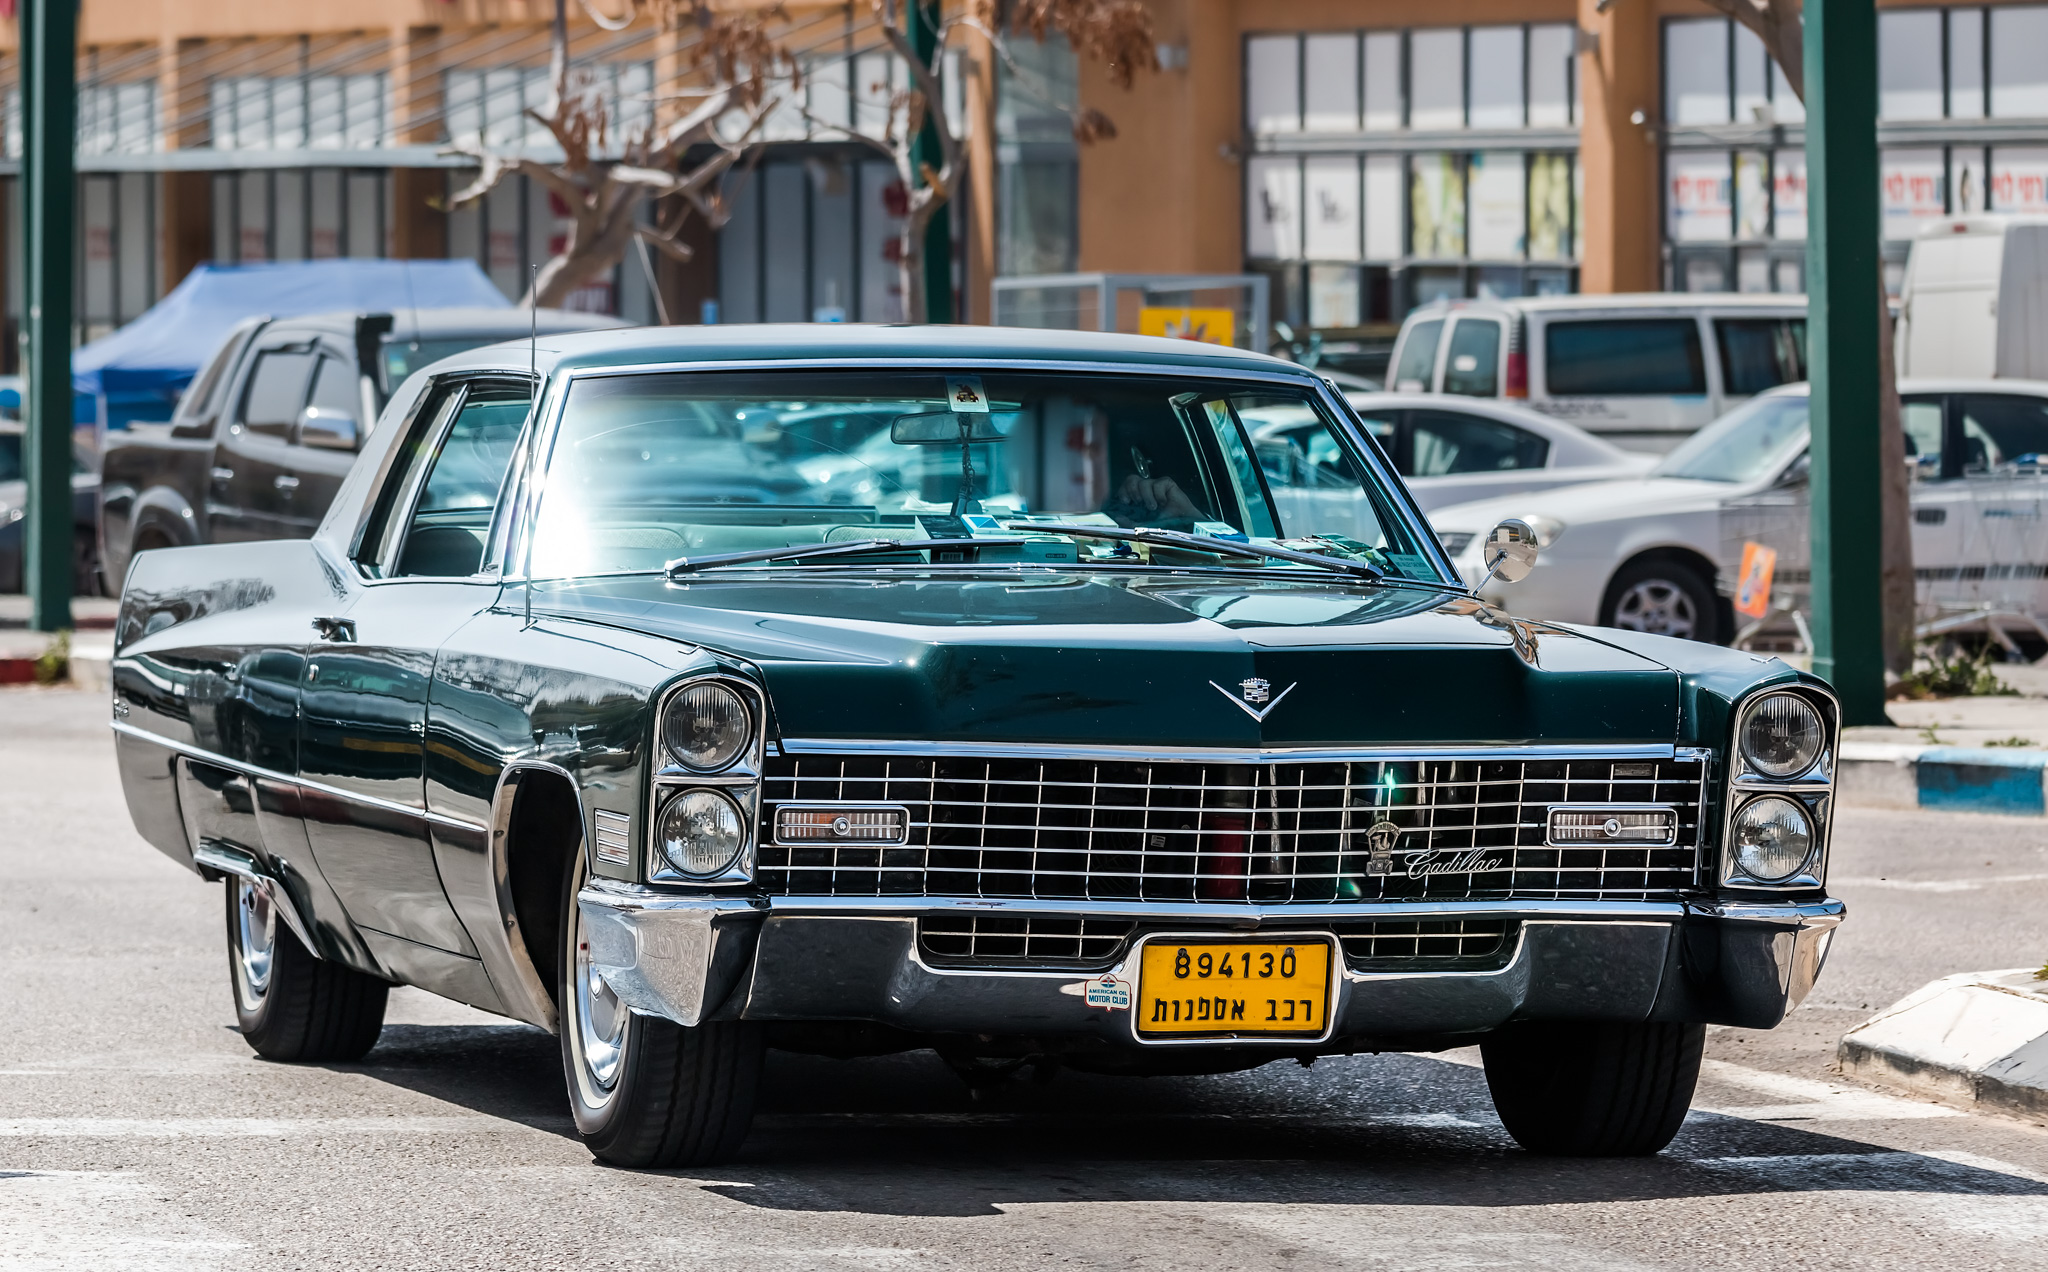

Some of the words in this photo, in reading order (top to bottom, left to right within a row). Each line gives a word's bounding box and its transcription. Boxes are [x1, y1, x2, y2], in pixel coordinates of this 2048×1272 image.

[1404, 848, 1503, 880] Cadillac
[1174, 952, 1297, 979] 894130
[1088, 994, 1111, 1003] MOTOR
[1112, 996, 1128, 1005] CLUB
[1151, 996, 1245, 1022] אספנות
[1265, 999, 1313, 1022] רכב
